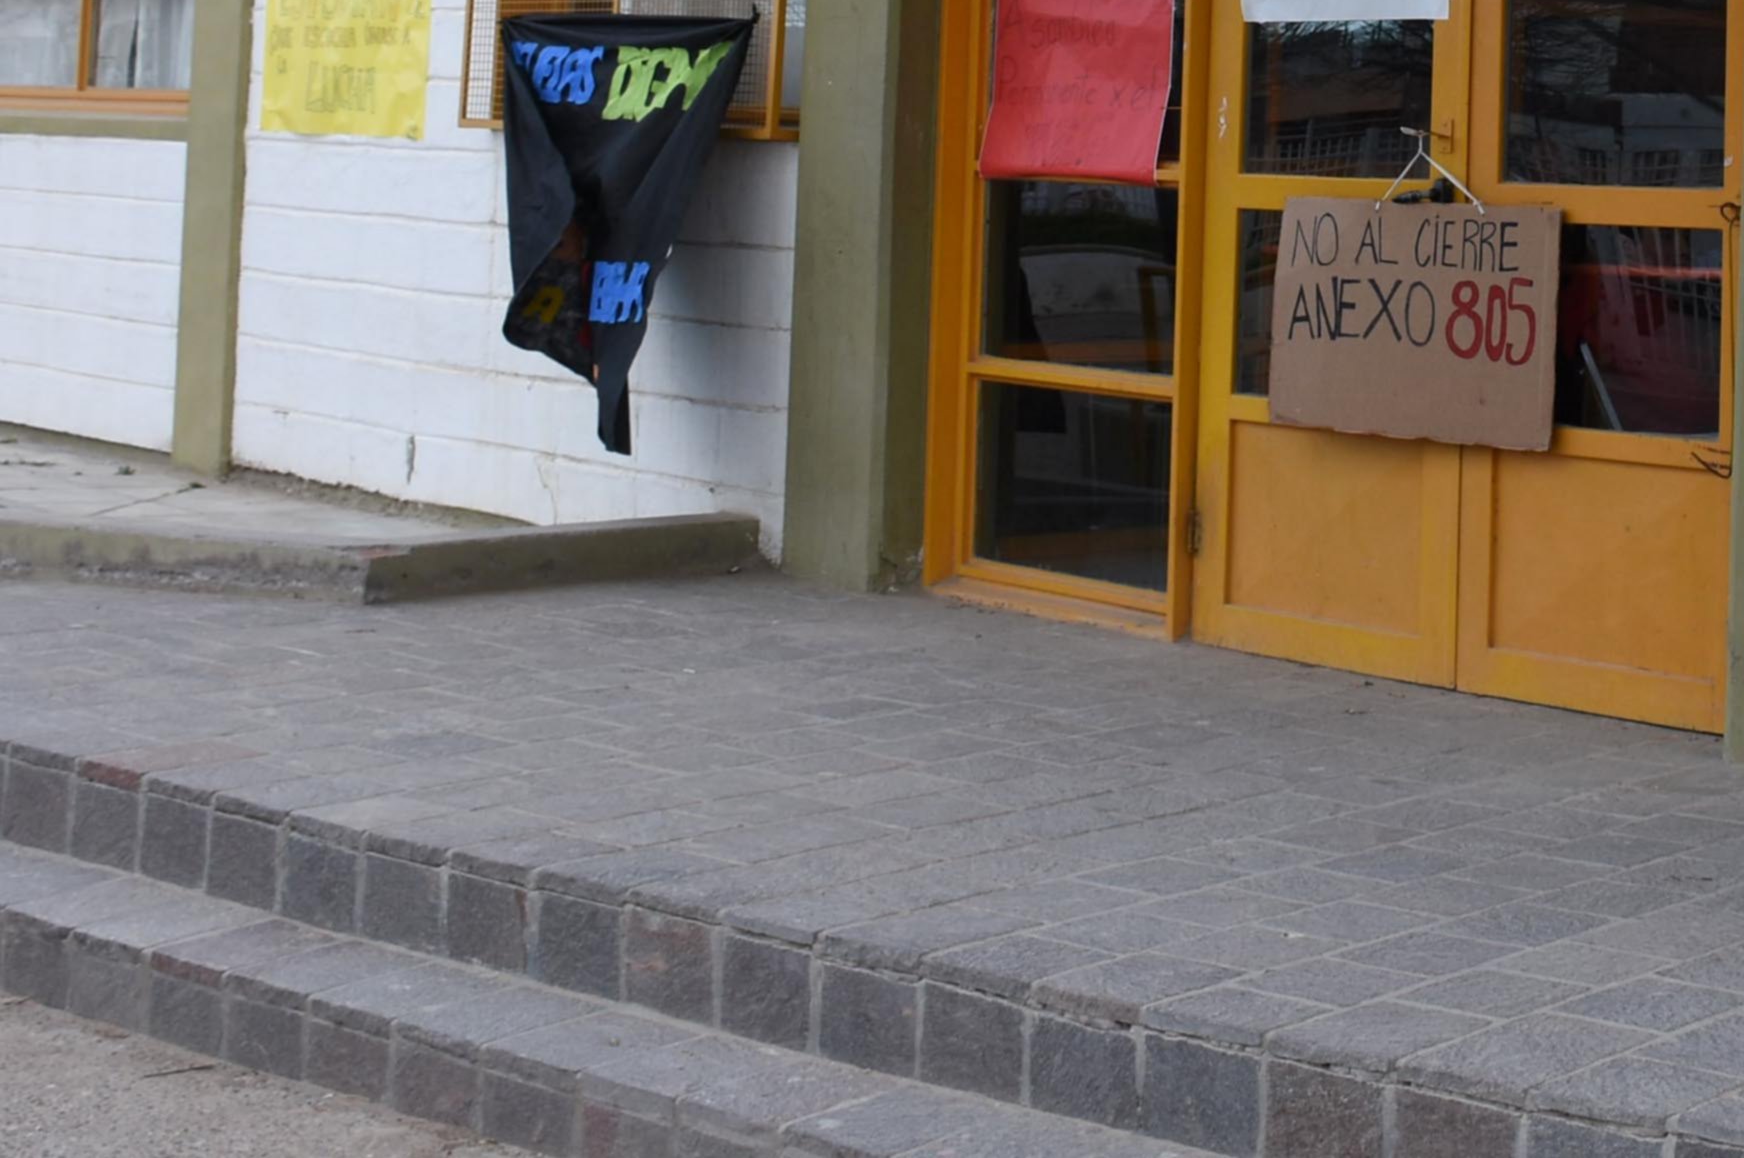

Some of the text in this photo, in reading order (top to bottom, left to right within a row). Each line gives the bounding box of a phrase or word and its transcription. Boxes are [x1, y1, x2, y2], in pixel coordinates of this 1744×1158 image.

[1291, 212, 1340, 267] NO
[1354, 216, 1399, 265] AL
[1288, 276, 1536, 366] ANEXO 805
